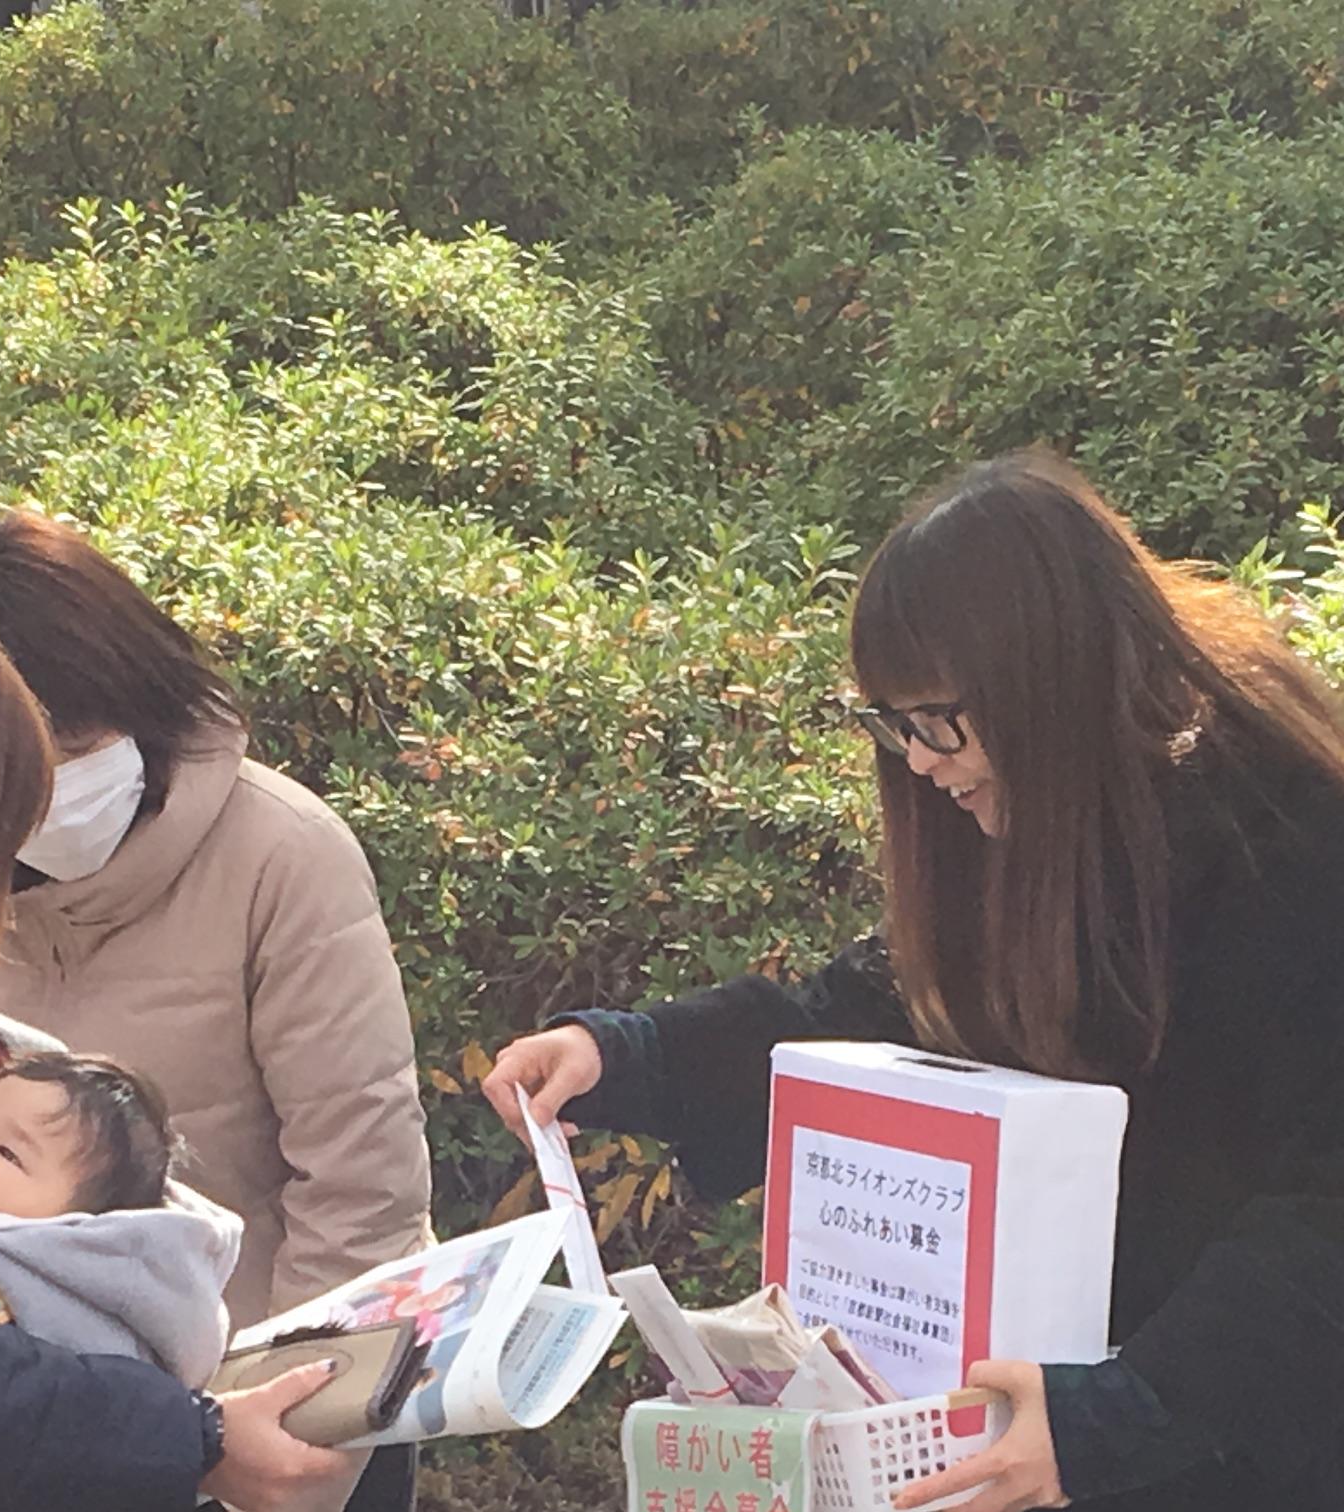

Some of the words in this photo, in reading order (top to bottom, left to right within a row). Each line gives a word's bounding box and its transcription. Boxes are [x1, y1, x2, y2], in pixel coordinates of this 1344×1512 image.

[806, 1151, 965, 1212] 京都北ライオンズクラブ
[819, 1200, 941, 1255] 心のふれあい募金
[656, 1421, 774, 1479] 障がい者
